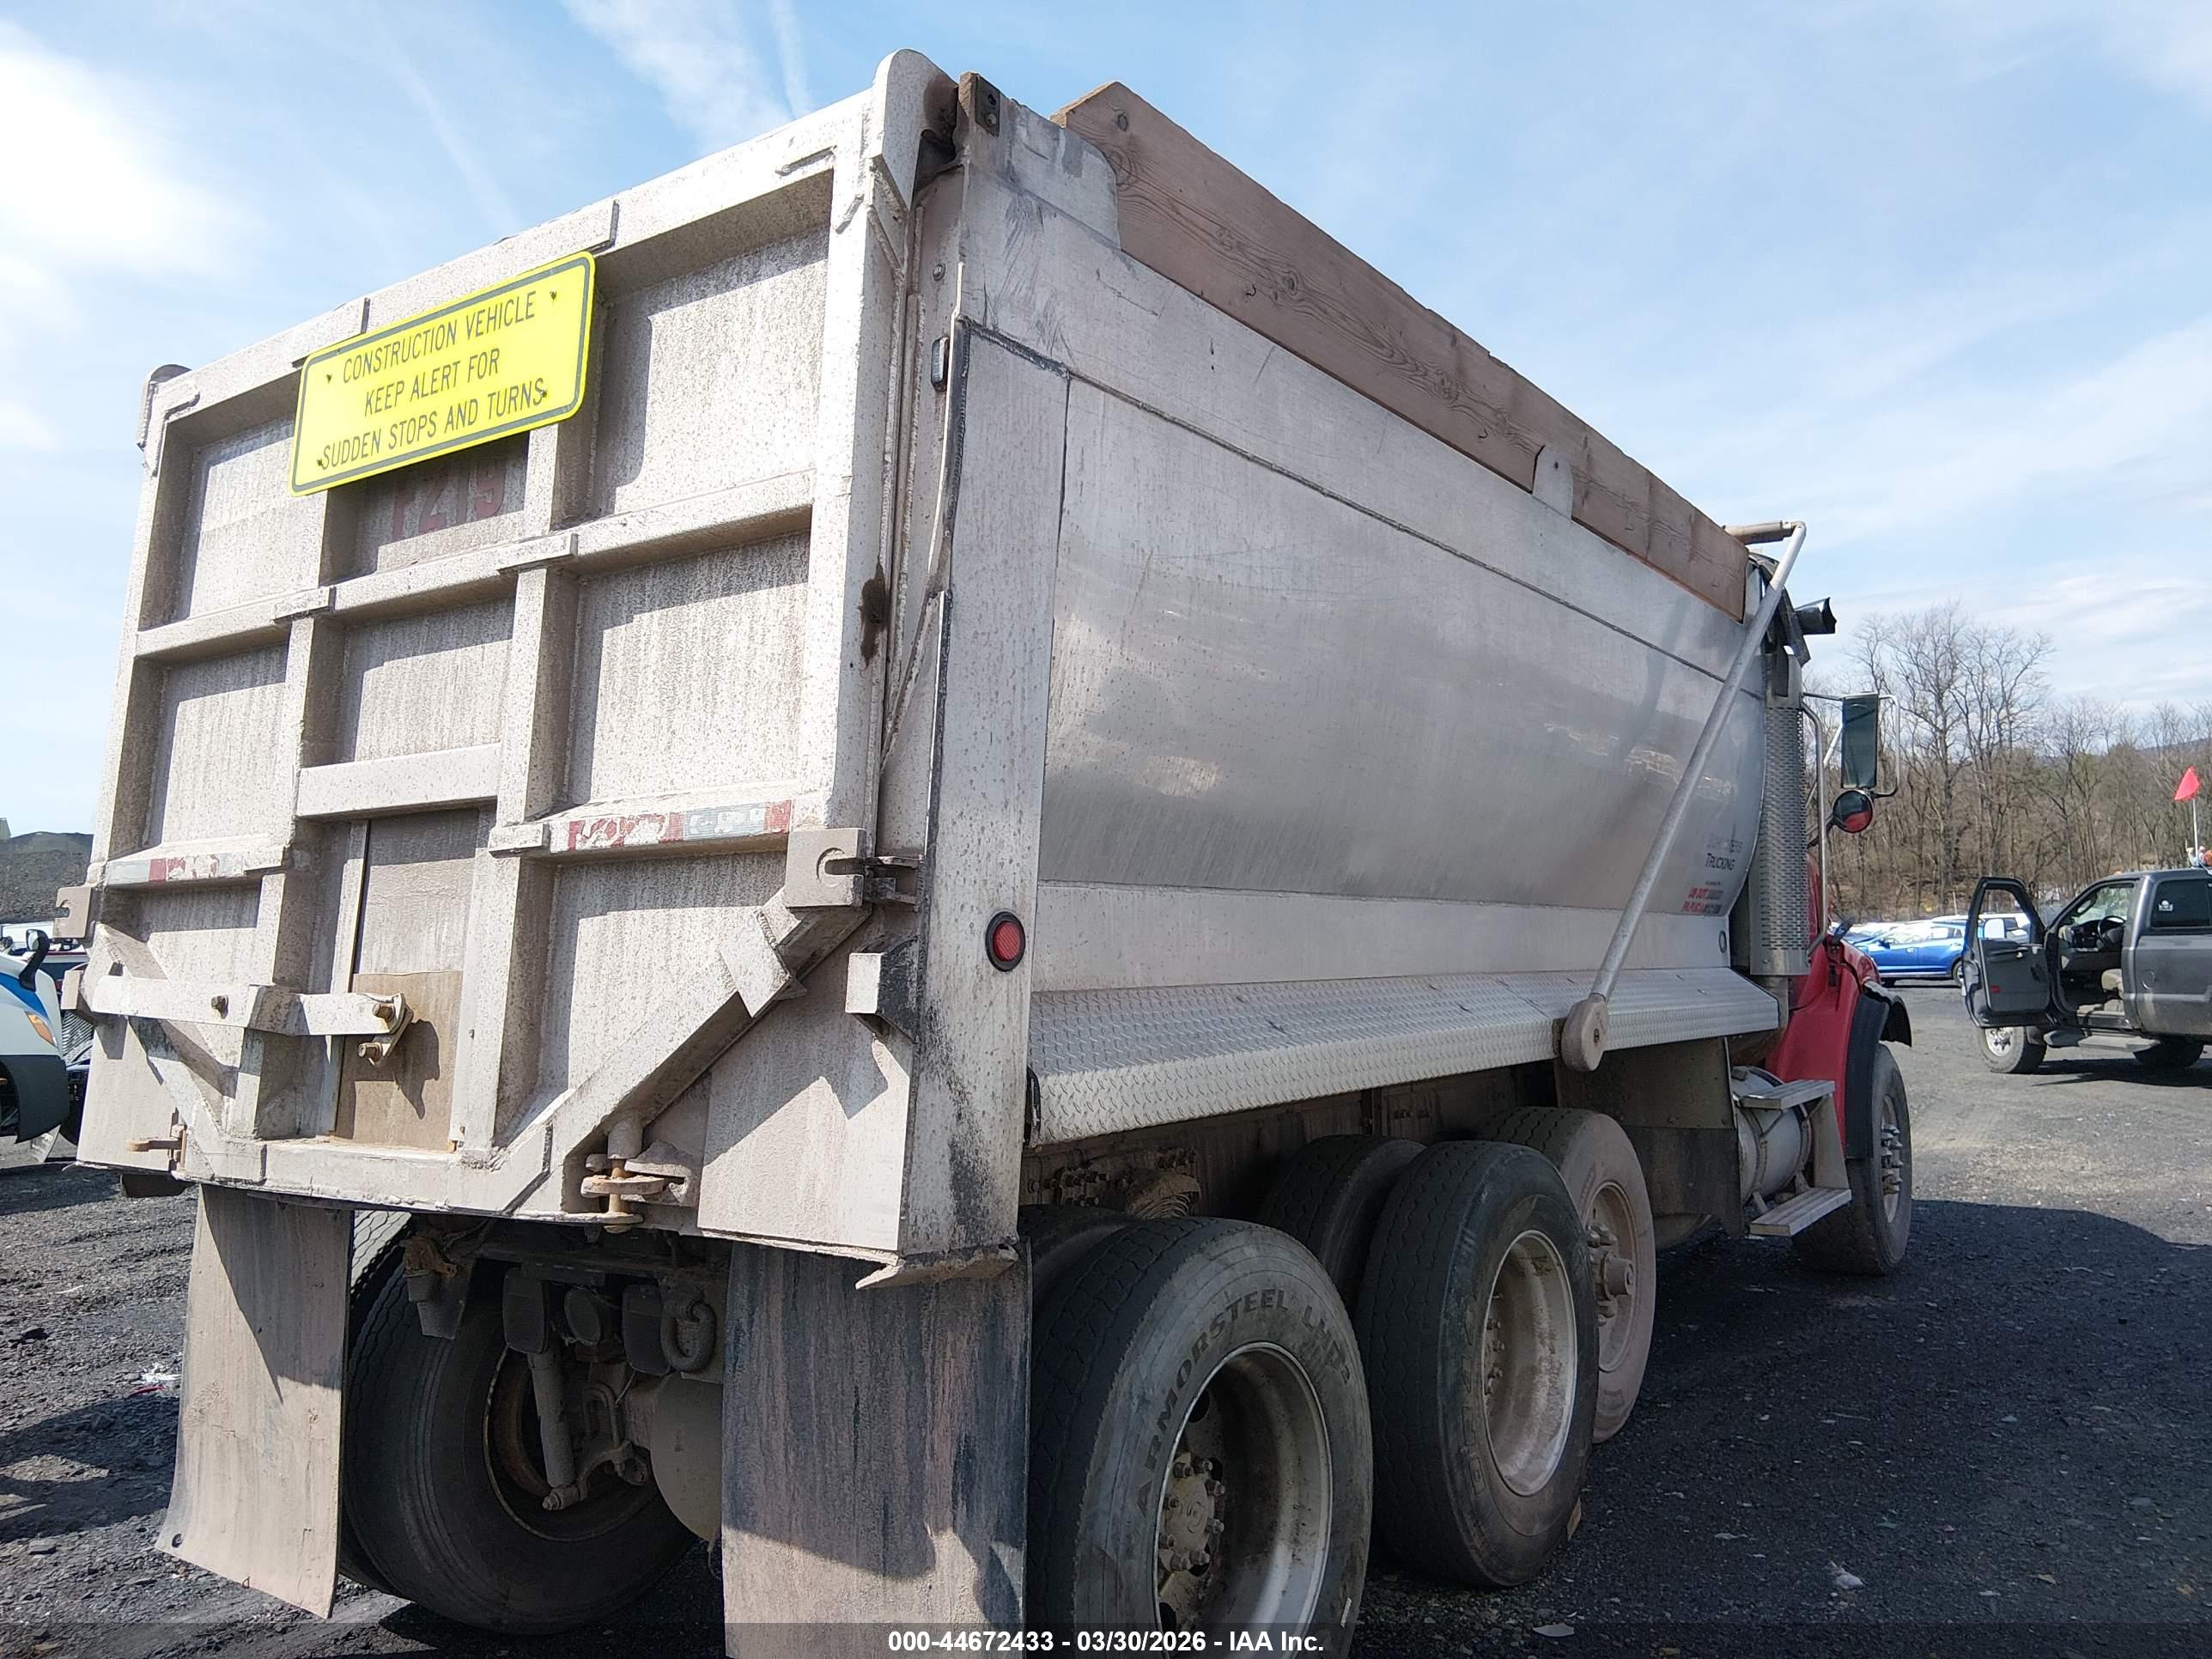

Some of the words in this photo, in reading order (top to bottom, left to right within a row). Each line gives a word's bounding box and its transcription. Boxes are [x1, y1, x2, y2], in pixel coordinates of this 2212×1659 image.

[343, 319, 458, 384] CONSTRUCTION
[465, 290, 536, 341] VEHICLE
[365, 380, 404, 417] KEEP
[410, 361, 461, 403] ALERT
[467, 348, 501, 383] FOR
[321, 428, 381, 471] SUDDEN
[388, 412, 437, 450] STOPS
[444, 398, 478, 434] AND
[487, 377, 544, 417] TURNS
[1138, 1288, 1288, 1516] ARMORSTEEL
